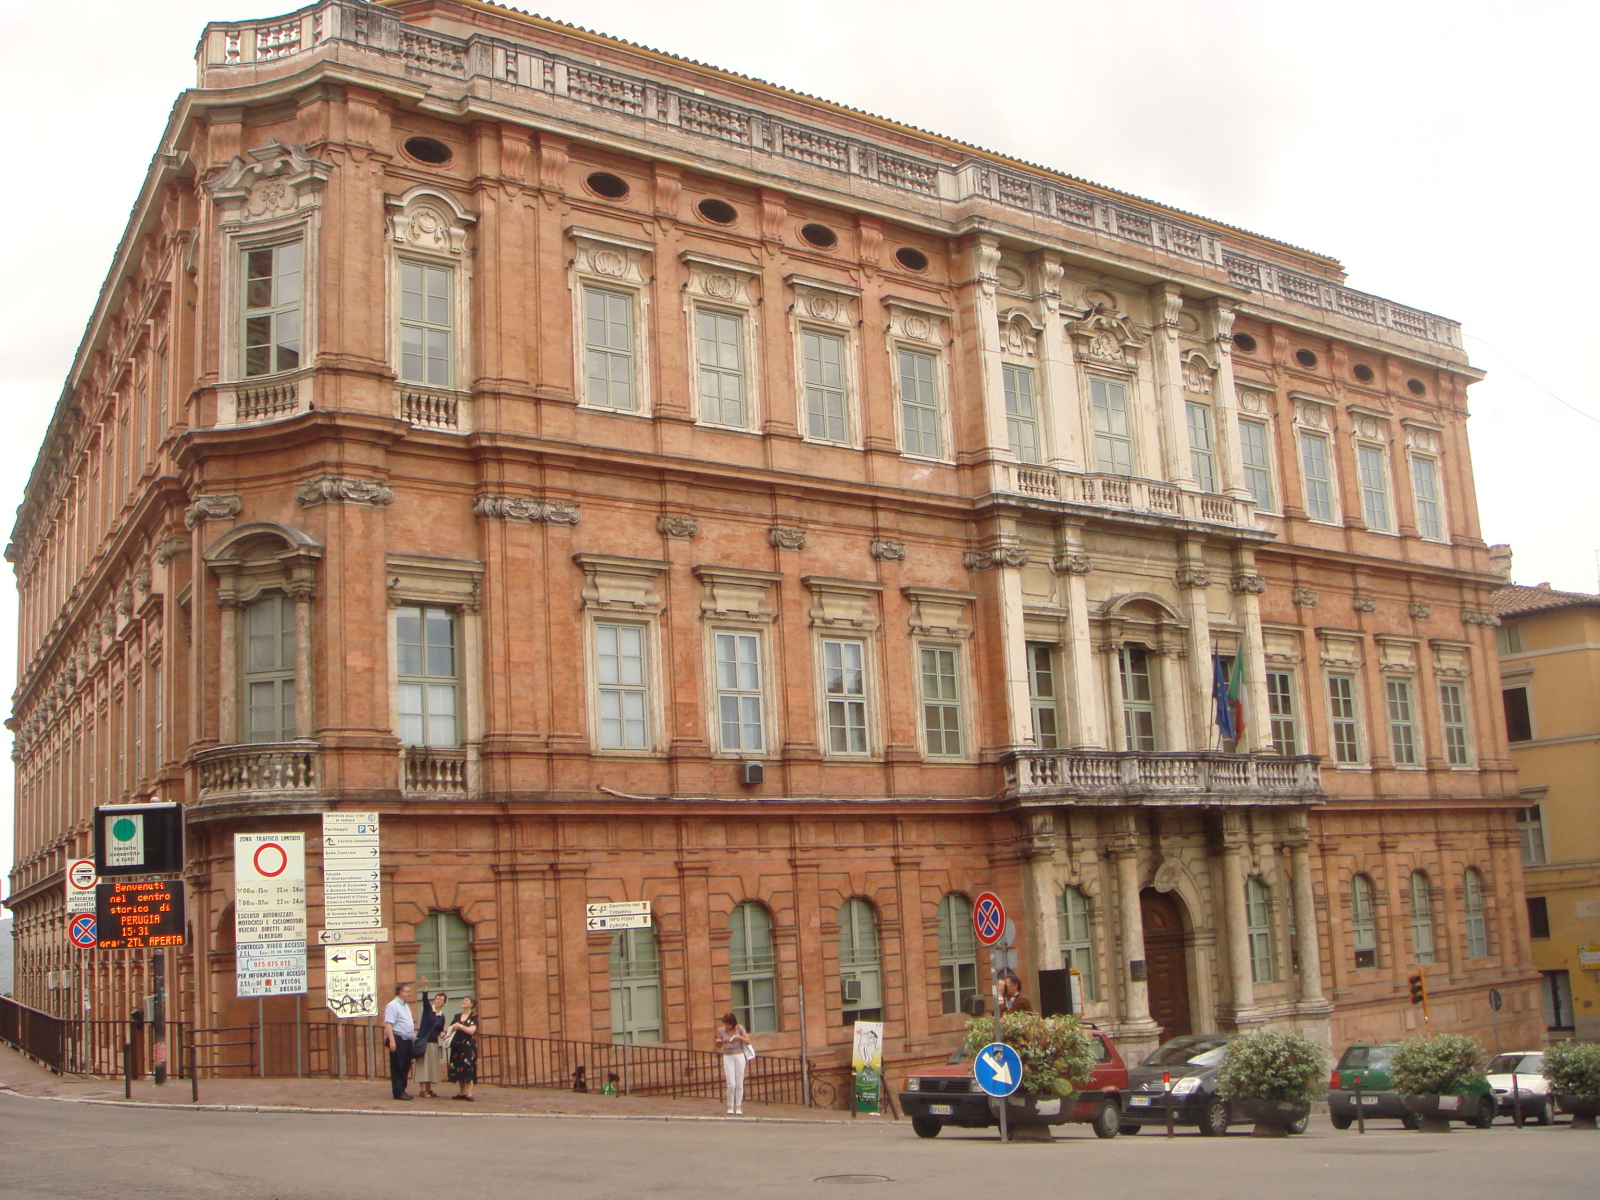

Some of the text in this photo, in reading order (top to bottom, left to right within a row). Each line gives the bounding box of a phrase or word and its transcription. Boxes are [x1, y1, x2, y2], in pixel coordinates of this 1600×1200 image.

[115, 882, 164, 892] Benvenuti
[110, 893, 170, 903] nel centro
[110, 903, 170, 914] storico di
[121, 915, 160, 925] PERUGIA
[122, 926, 148, 936] 15:31
[127, 937, 144, 947] ZTL
[149, 935, 183, 946] APERTA
